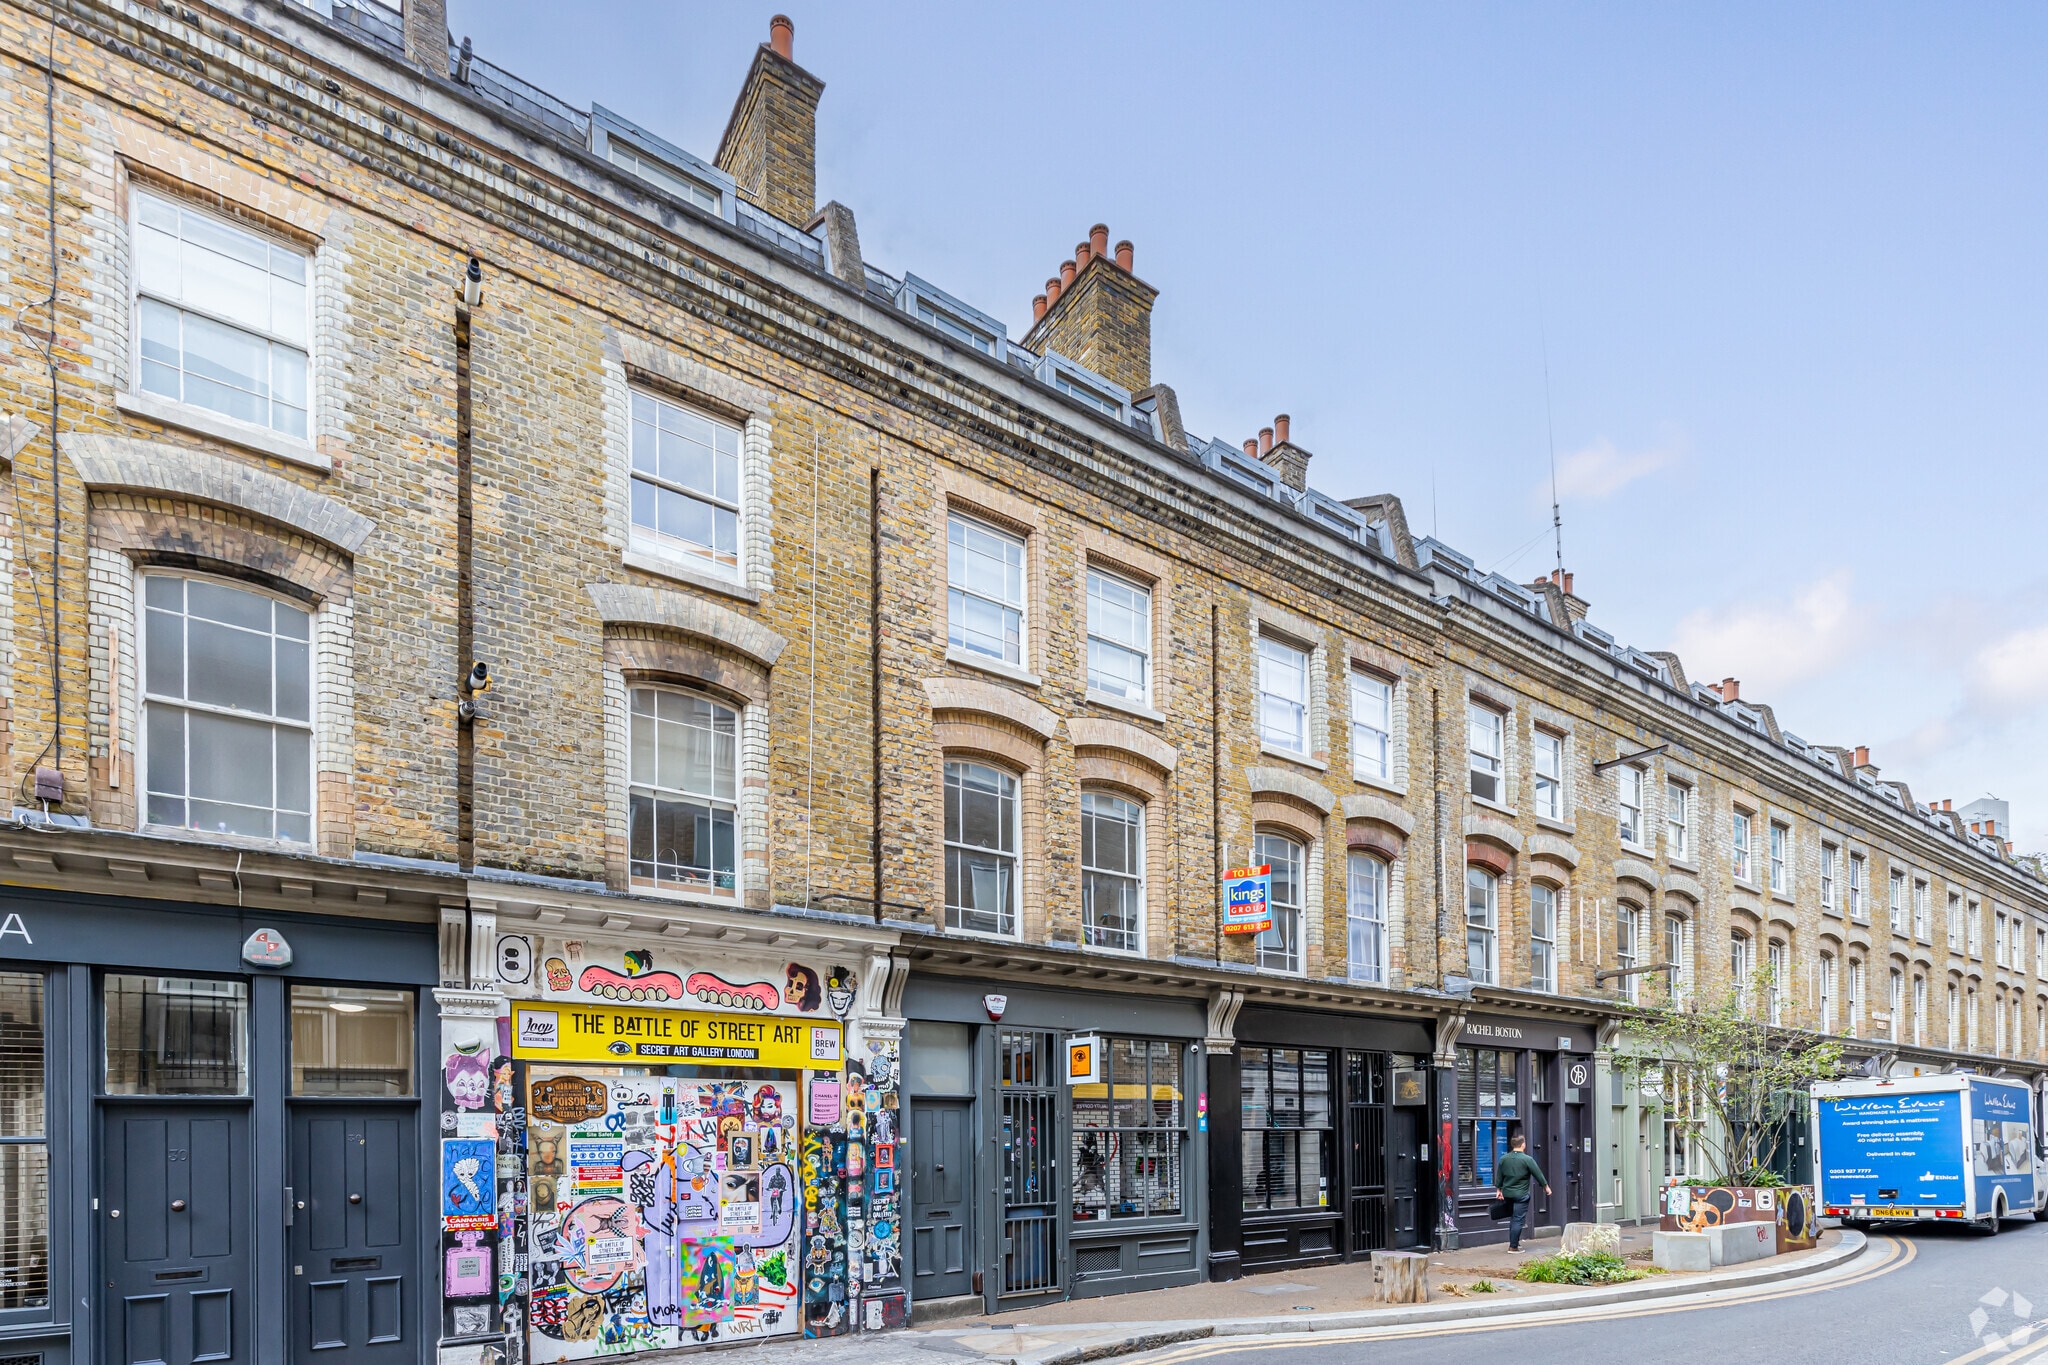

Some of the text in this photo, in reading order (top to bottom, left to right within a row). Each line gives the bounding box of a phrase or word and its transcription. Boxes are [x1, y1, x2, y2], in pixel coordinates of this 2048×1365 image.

[1232, 866, 1262, 878] TO LET
[1231, 888, 1264, 903] kings
[1231, 904, 1265, 914] GROUP
[0, 913, 33, 945] A
[572, 1013, 802, 1044] THE BATTLE OF STREET ART
[815, 1030, 824, 1039] E1
[1466, 1024, 1522, 1038] RACHEL BOSTON
[815, 1039, 836, 1048] BREW
[640, 1044, 755, 1058] SECRET ART GALLERY LONDON
[552, 1096, 586, 1106] POISON
[1834, 1096, 1946, 1112] Warren Evans
